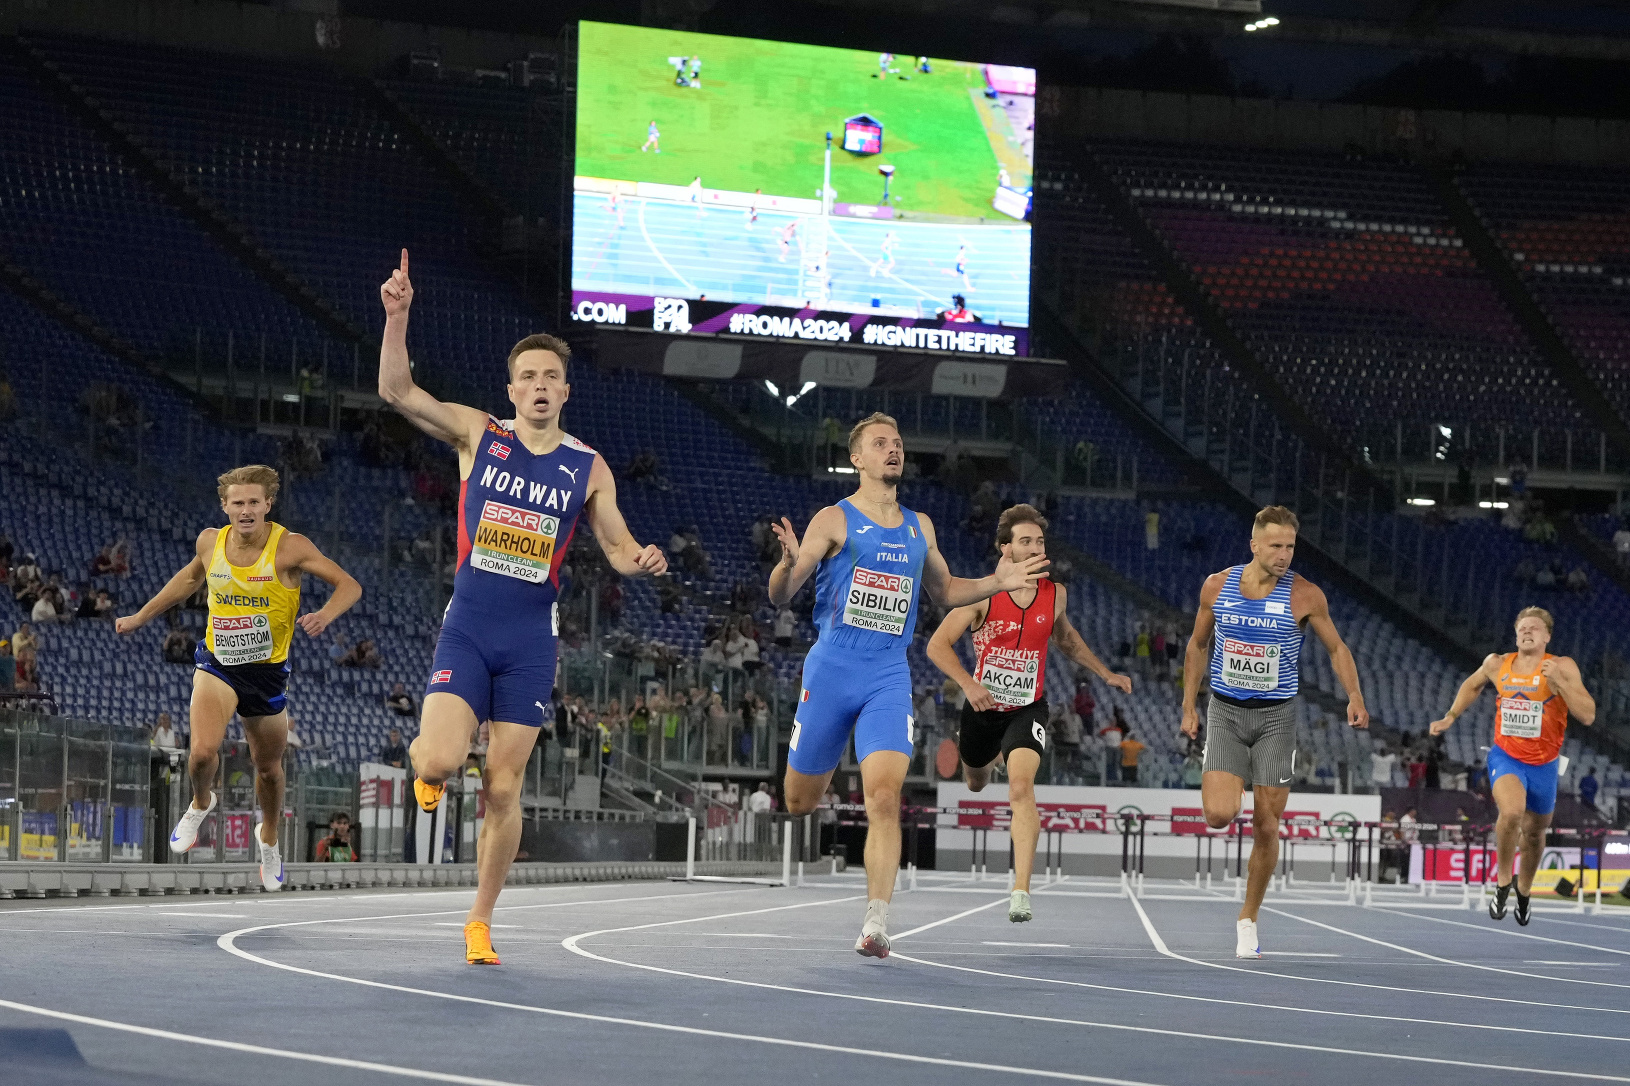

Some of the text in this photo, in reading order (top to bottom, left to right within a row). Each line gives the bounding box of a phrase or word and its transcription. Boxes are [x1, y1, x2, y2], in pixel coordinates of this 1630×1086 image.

[730, 312, 851, 342] #ROMA2024
[863, 324, 1015, 355] #IGNITETHEFIRE
[480, 464, 572, 512] NORWAY
[485, 504, 540, 530] SPAR
[477, 525, 551, 559] WARHOLM
[491, 551, 508, 561] RUN
[876, 552, 909, 564] ITALIA
[480, 557, 538, 580] ROMA 2024
[855, 572, 899, 590] SPAR
[215, 593, 270, 607] SWEDEN
[849, 590, 909, 614] SIBILIO
[213, 617, 252, 629] SPAR
[851, 617, 901, 633] ROMA 2024
[1221, 614, 1278, 628] ESTONIA
[215, 630, 270, 647] BENGTSTRÖM
[1225, 641, 1265, 656] SPAR
[222, 653, 267, 664] ROMA 2024
[986, 656, 1025, 671] SPAR
[1230, 657, 1270, 674] MÄGI
[983, 669, 1034, 690] AKÇAM
[1228, 679, 1250, 687] ROMA
[991, 693, 1026, 705] OMA 2024
[1502, 701, 1530, 710] SPAR
[1503, 712, 1538, 725] SMIDT
[1037, 728, 1042, 741] 6
